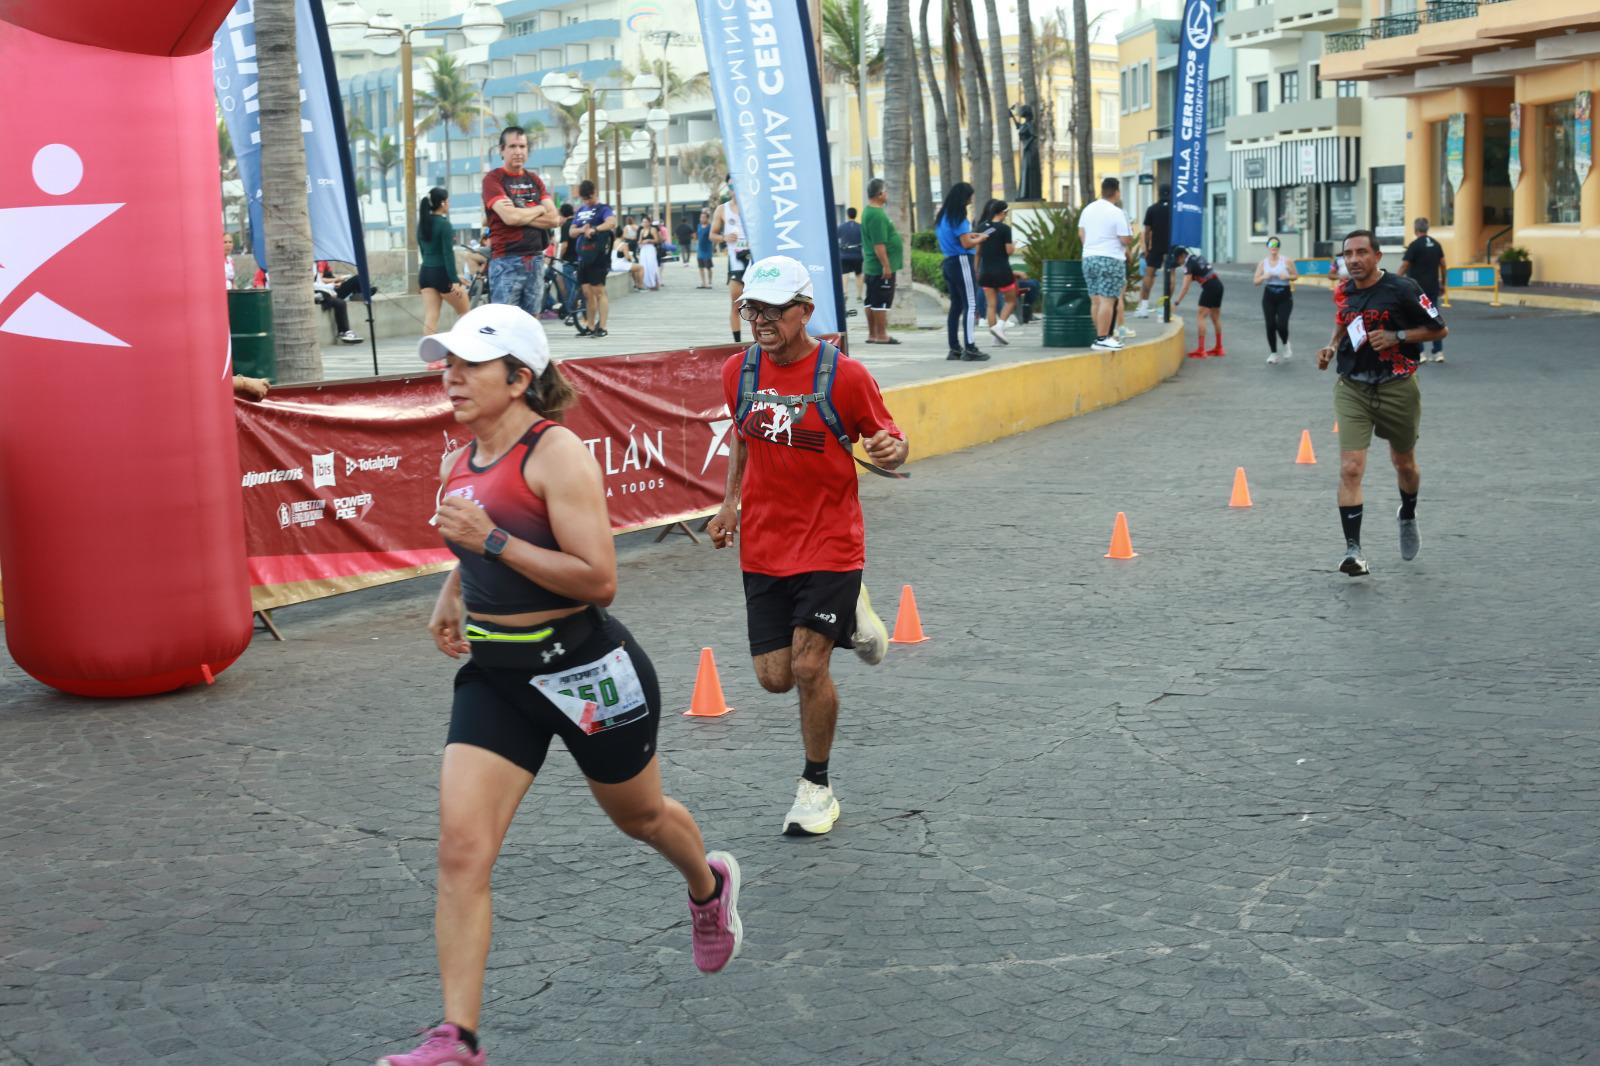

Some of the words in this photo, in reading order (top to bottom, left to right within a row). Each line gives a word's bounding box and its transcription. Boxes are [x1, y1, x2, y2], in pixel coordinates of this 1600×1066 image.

[1181, 50, 1197, 141] CERRITOS
[1194, 63, 1205, 138] RESIDENCIAL
[1176, 148, 1192, 198] VILLA
[1192, 140, 1202, 194] RANCHO
[315, 463, 332, 477] ibis
[358, 455, 399, 471] Totalplay
[333, 493, 372, 509] POWER
[620, 478, 665, 495] TODOS
